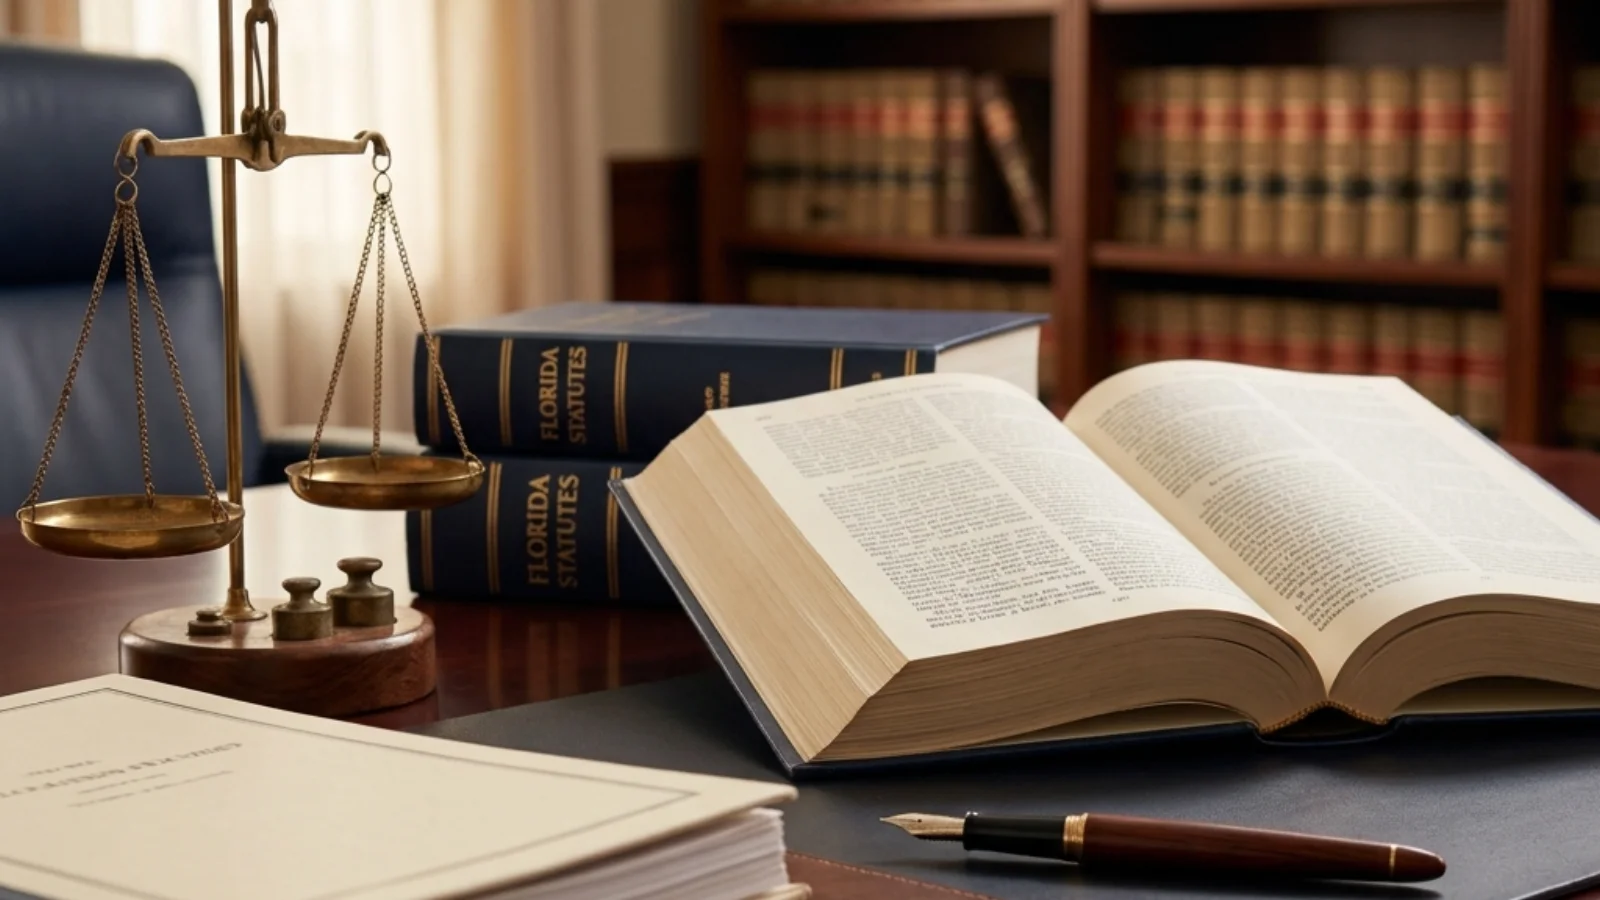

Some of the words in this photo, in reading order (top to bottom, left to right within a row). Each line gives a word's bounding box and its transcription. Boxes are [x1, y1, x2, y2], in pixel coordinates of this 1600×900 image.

[539, 346, 560, 440] FLORIDA
[567, 345, 588, 444] STATUTES
[526, 474, 551, 585] FLORIDA
[556, 474, 580, 588] STATUTES
